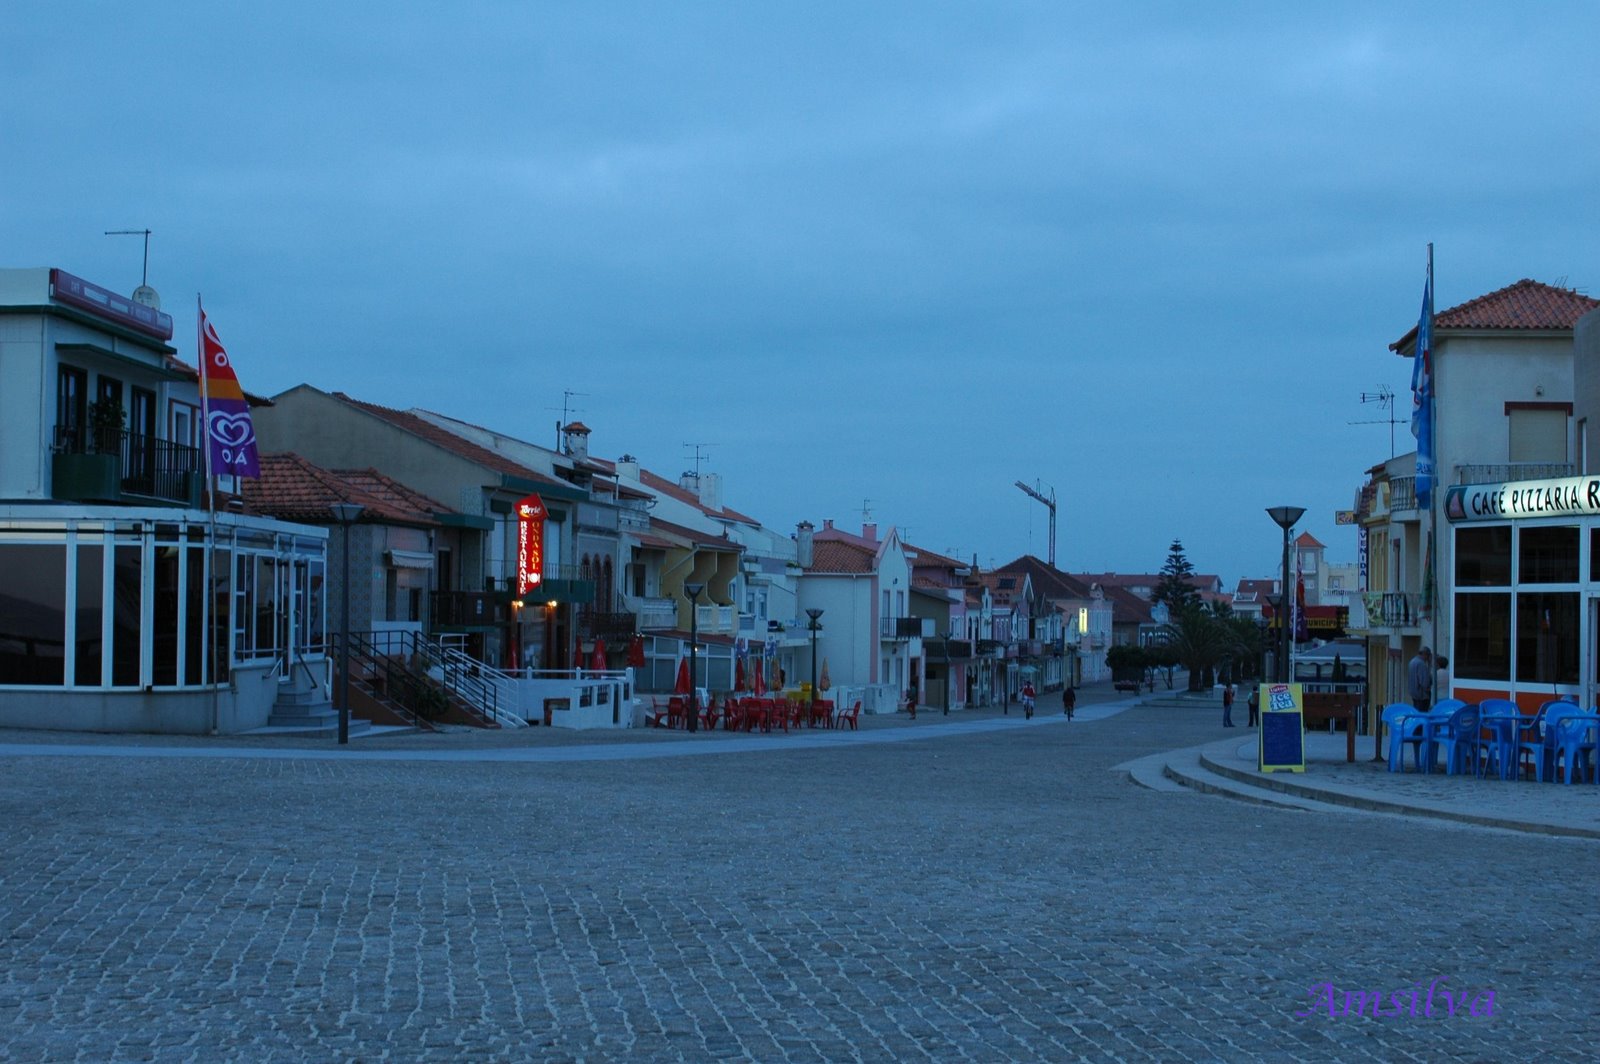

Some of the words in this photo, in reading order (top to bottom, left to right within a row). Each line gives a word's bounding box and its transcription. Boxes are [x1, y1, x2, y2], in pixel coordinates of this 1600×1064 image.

[221, 447, 248, 465] OÁ
[1472, 486, 1506, 515] CAFÉ
[1512, 486, 1582, 512] PIZZARIA
[519, 521, 527, 595] RESTAURANTE
[1271, 692, 1290, 702] Ice
[1271, 699, 1293, 710] Tea
